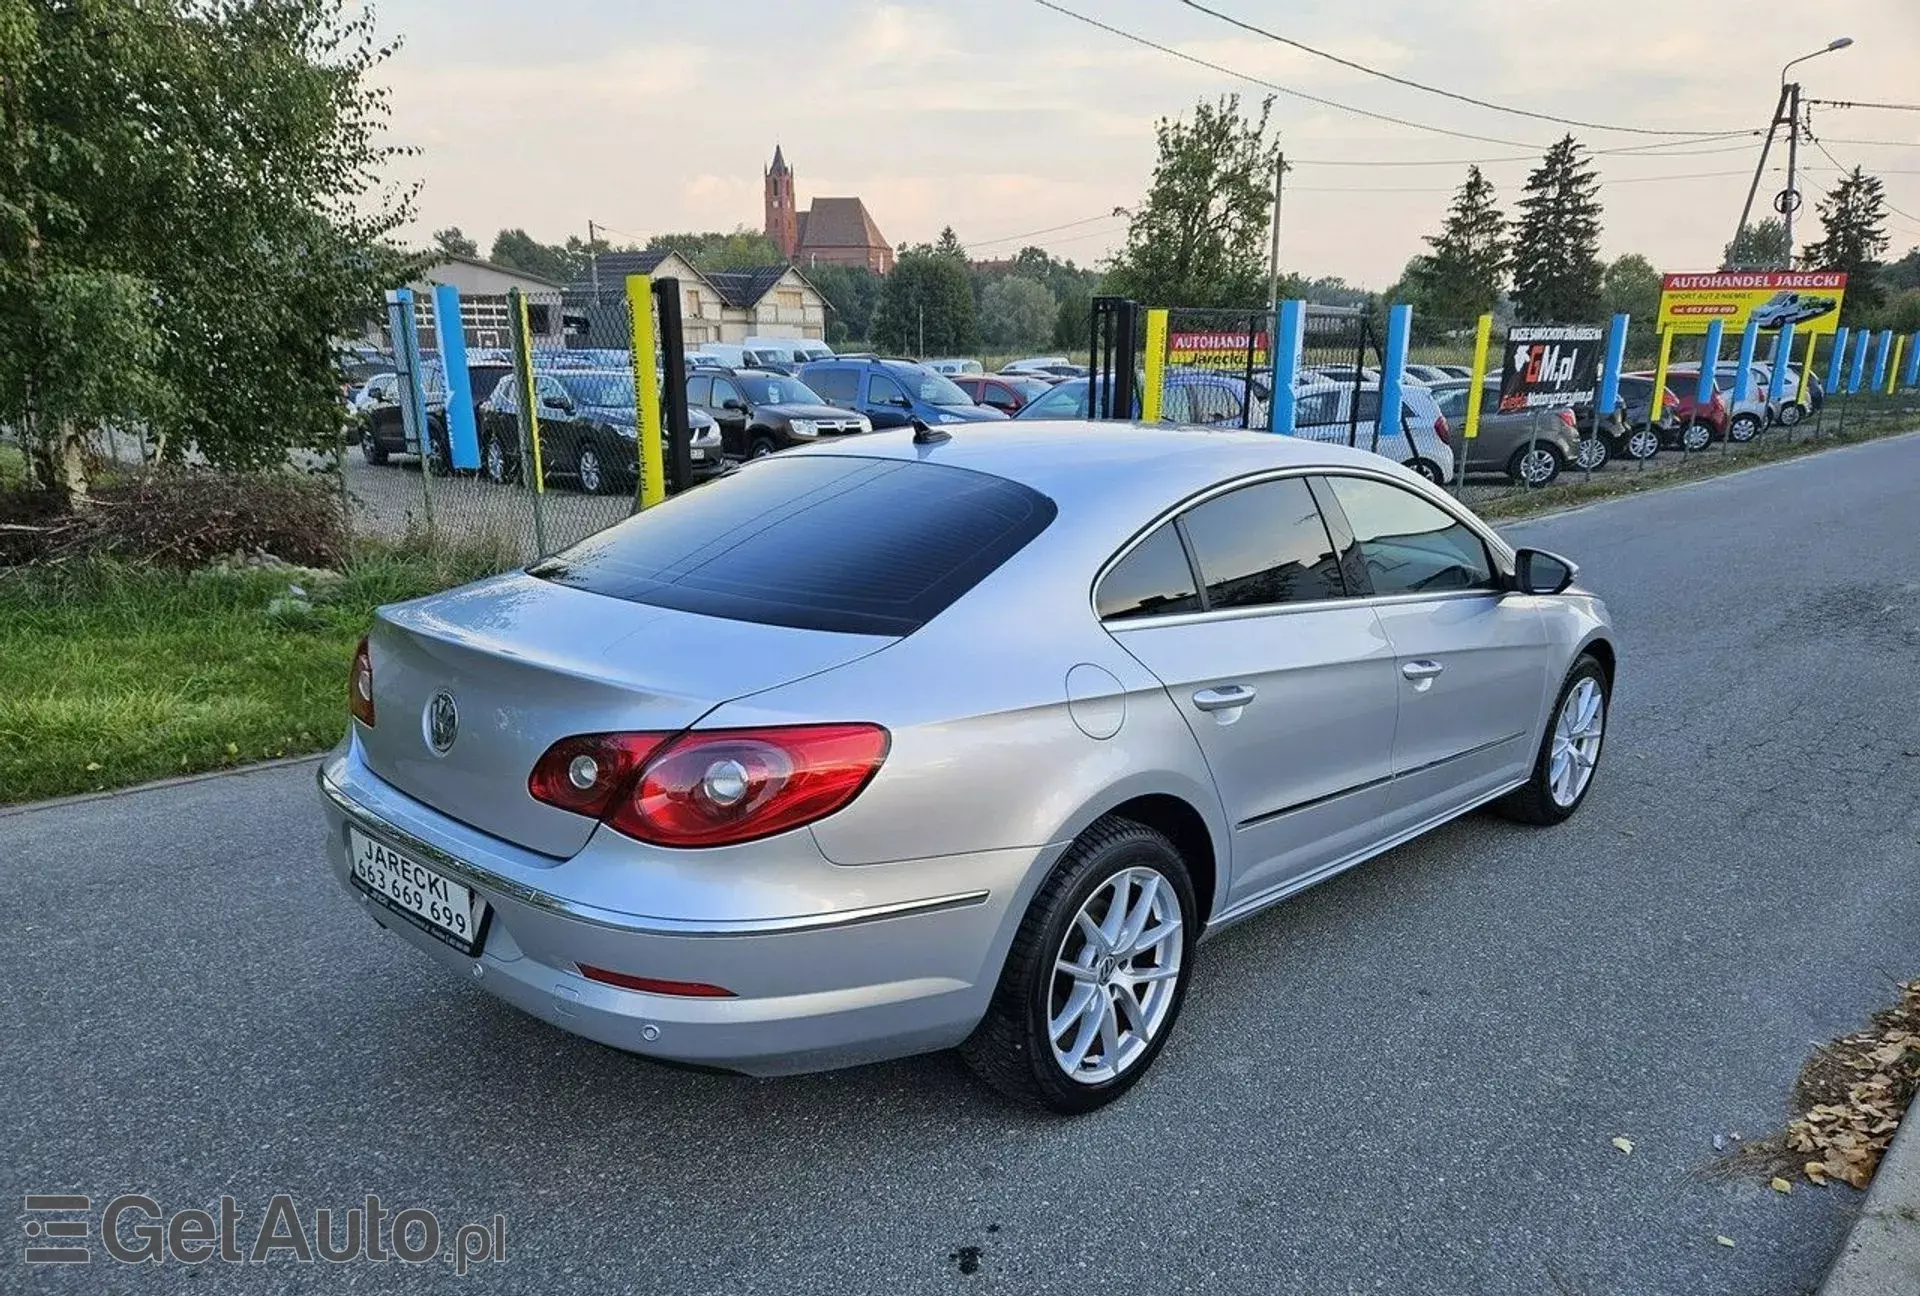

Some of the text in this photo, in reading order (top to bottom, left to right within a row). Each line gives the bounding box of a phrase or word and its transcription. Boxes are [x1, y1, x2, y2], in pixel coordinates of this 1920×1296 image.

[1670, 275, 1841, 288] AUTOHANDEL JARECKI
[1192, 352, 1244, 365] Jarecki
[365, 841, 449, 902] JARECKI
[358, 859, 386, 889] 663
[391, 879, 423, 911] 669
[430, 901, 466, 934] 699
